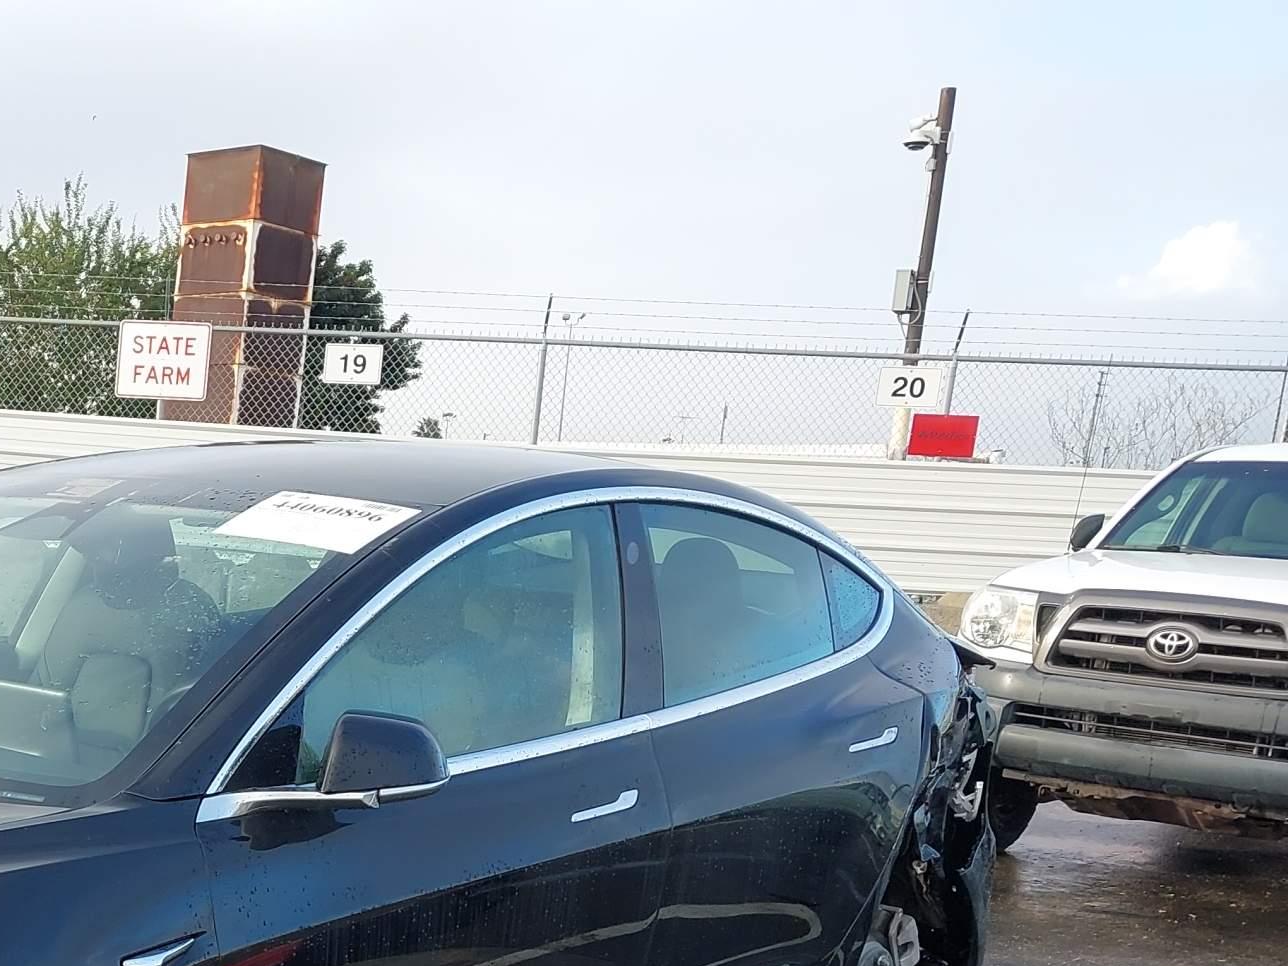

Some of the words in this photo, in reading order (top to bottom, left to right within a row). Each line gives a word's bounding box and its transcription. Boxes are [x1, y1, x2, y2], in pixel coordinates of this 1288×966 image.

[132, 335, 197, 356] STATE
[339, 354, 367, 374] 19
[133, 365, 191, 386] FARM
[891, 376, 925, 398] 20
[273, 500, 383, 522] 44060896
